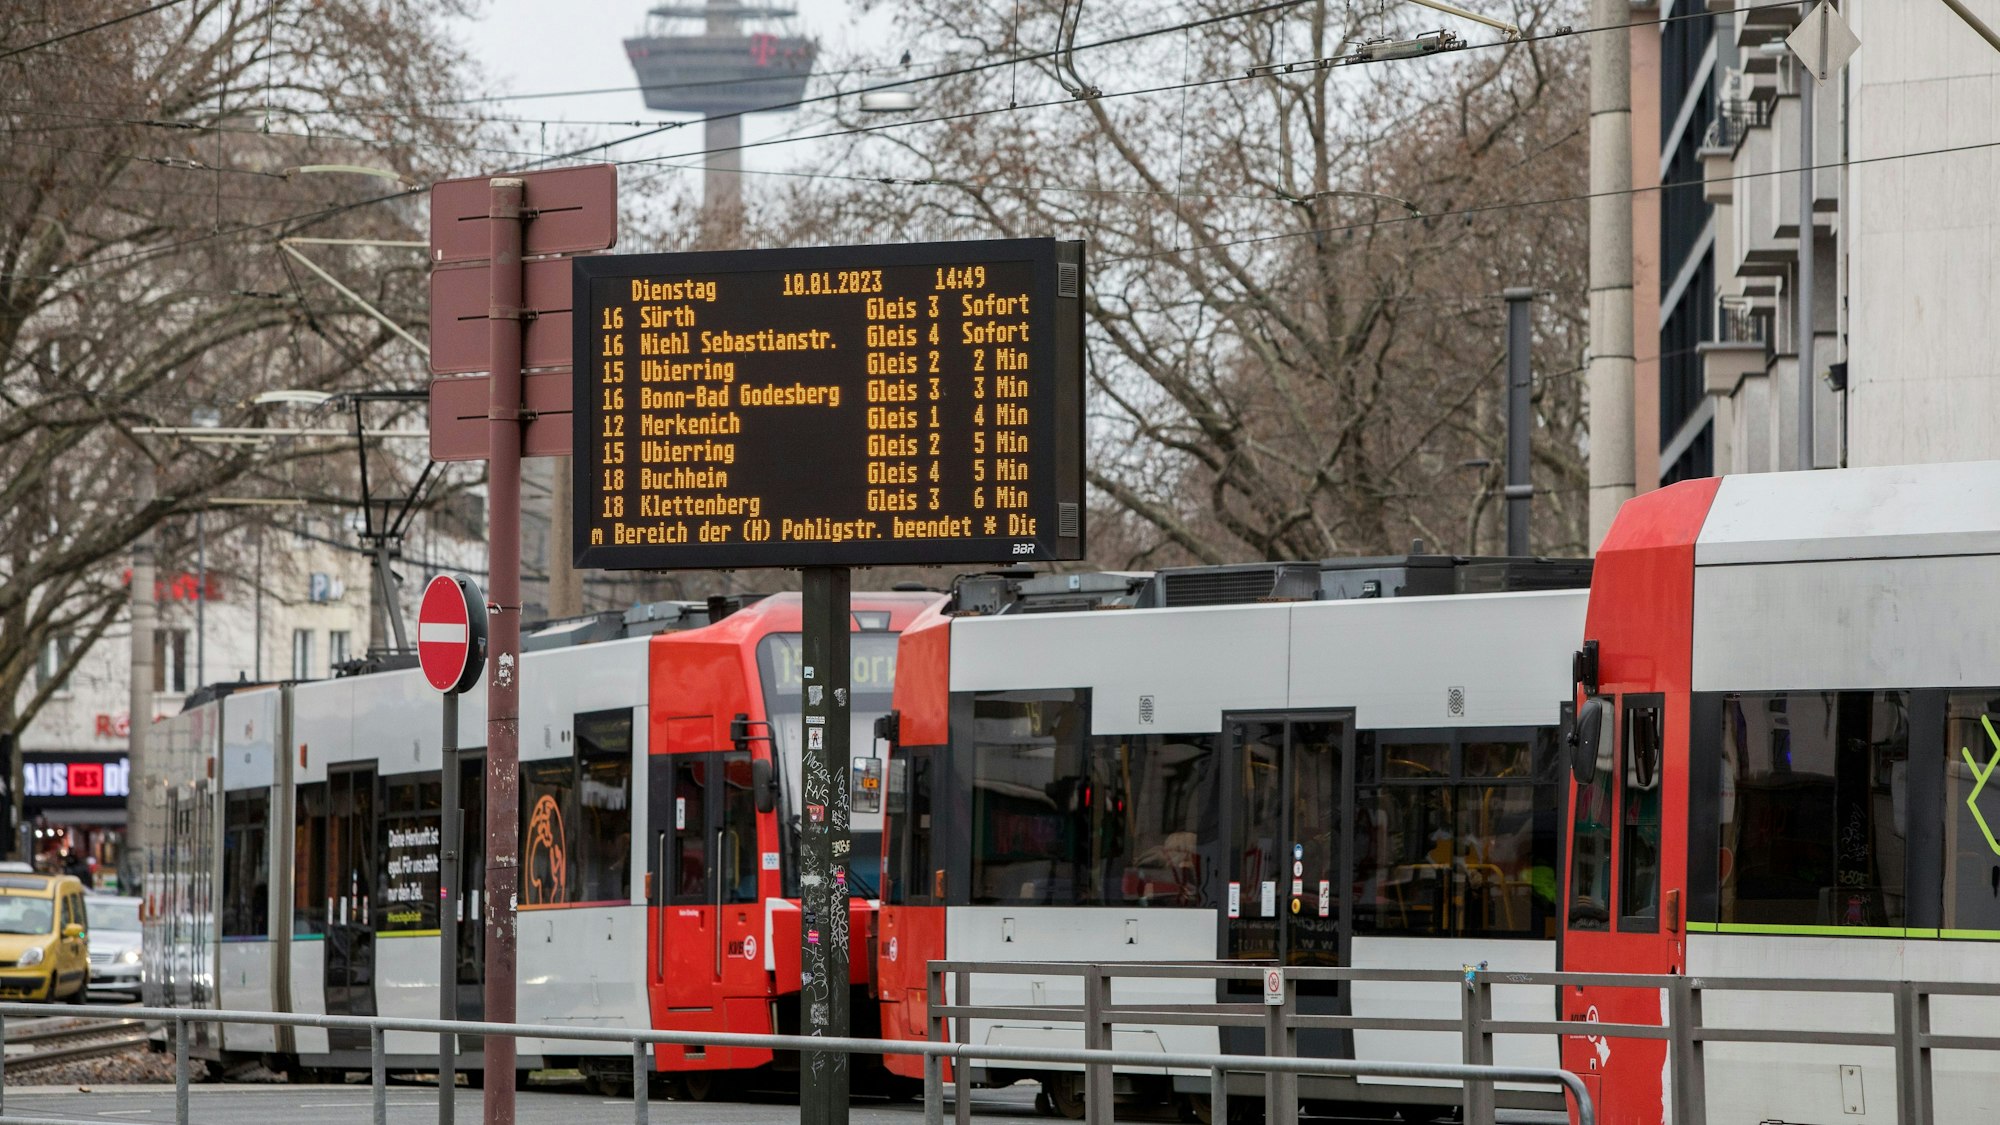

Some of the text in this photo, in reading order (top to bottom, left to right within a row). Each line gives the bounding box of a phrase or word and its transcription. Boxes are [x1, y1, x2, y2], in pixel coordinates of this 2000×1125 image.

[631, 265, 986, 303] Dienstag 10.01.2023 14:49
[602, 292, 1030, 330] 16 Sürth Gleis 3 Sofort
[602, 320, 1030, 357] 16 Niehl Sebastianstr. Gleis 4 Sofort
[602, 347, 1028, 384] 15 Ubierring Gleis 2 2 Min
[602, 375, 1028, 411] 16 Bonn-Bad Godesberg Gleis 3 3 Min
[602, 402, 1029, 438] 12 Merkenich Gleis 1 4 Min
[602, 430, 1028, 465] 15 Ubierring Gleis 2 5 Min
[602, 458, 1028, 491] 18 Buchheim Gleis 4 5 Min
[602, 485, 1028, 518] 18 Klettenberg Gleis 3 6 Min
[614, 520, 688, 545] Bereich
[698, 520, 732, 543] der
[742, 518, 771, 542] (H)
[781, 517, 883, 543] Pohligstr.
[893, 514, 972, 539] beendet
[1012, 543, 1035, 554] BBR
[73, 770, 99, 788] DES
